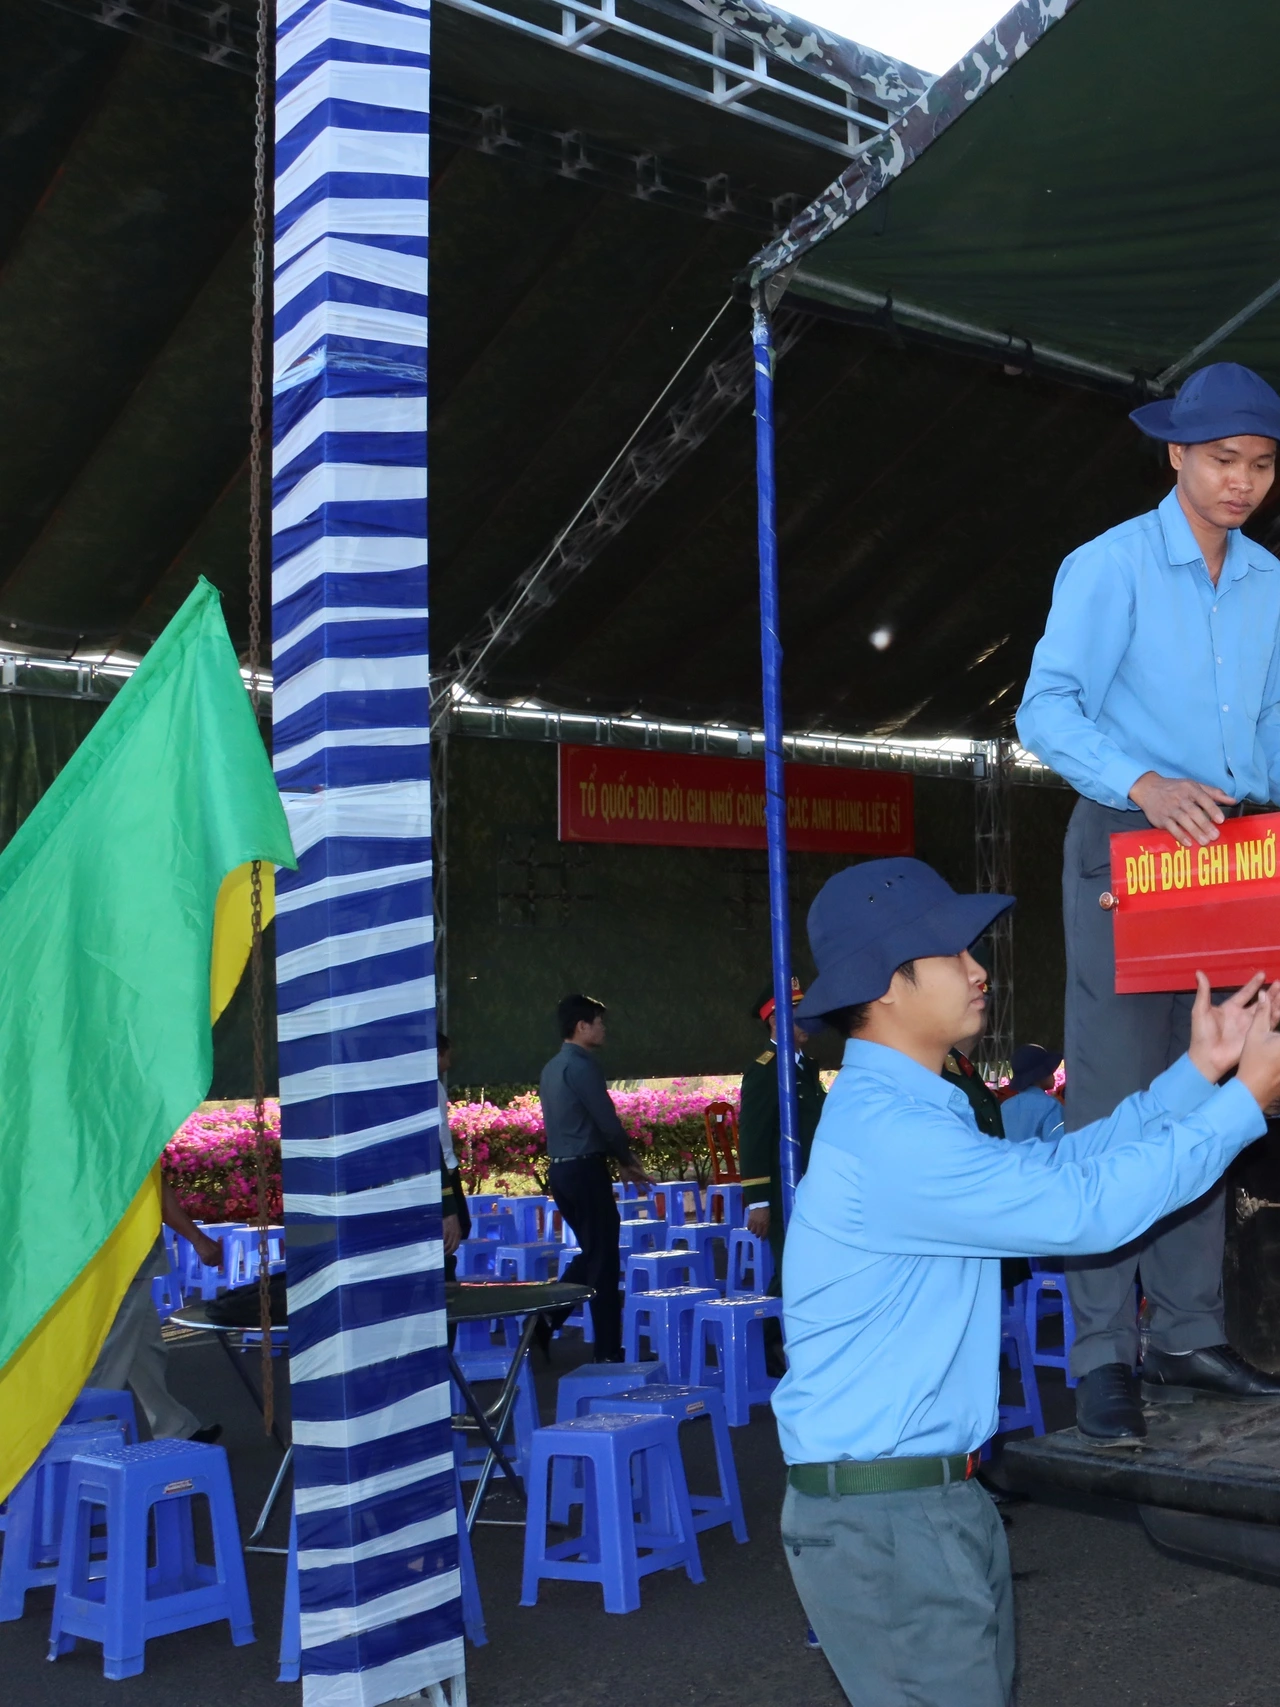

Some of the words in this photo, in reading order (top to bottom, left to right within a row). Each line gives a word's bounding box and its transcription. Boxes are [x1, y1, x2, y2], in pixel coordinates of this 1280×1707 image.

[579, 763, 598, 818] TỔ
[601, 771, 634, 825] QUỐC
[637, 776, 659, 820] ĐỜI
[662, 778, 684, 822] ĐỜI
[686, 788, 706, 824] GHI
[709, 783, 734, 825] NHỚ
[787, 787, 808, 829] CÁC
[811, 797, 832, 831] ANH
[835, 791, 864, 832] HÙNG
[866, 793, 888, 840] LIỆT
[890, 795, 901, 834] SĨ
[1125, 846, 1156, 896] ĐỜI
[1161, 841, 1192, 891] ĐỜI
[1198, 843, 1229, 887] GHI
[1235, 829, 1277, 882] NHỚ
